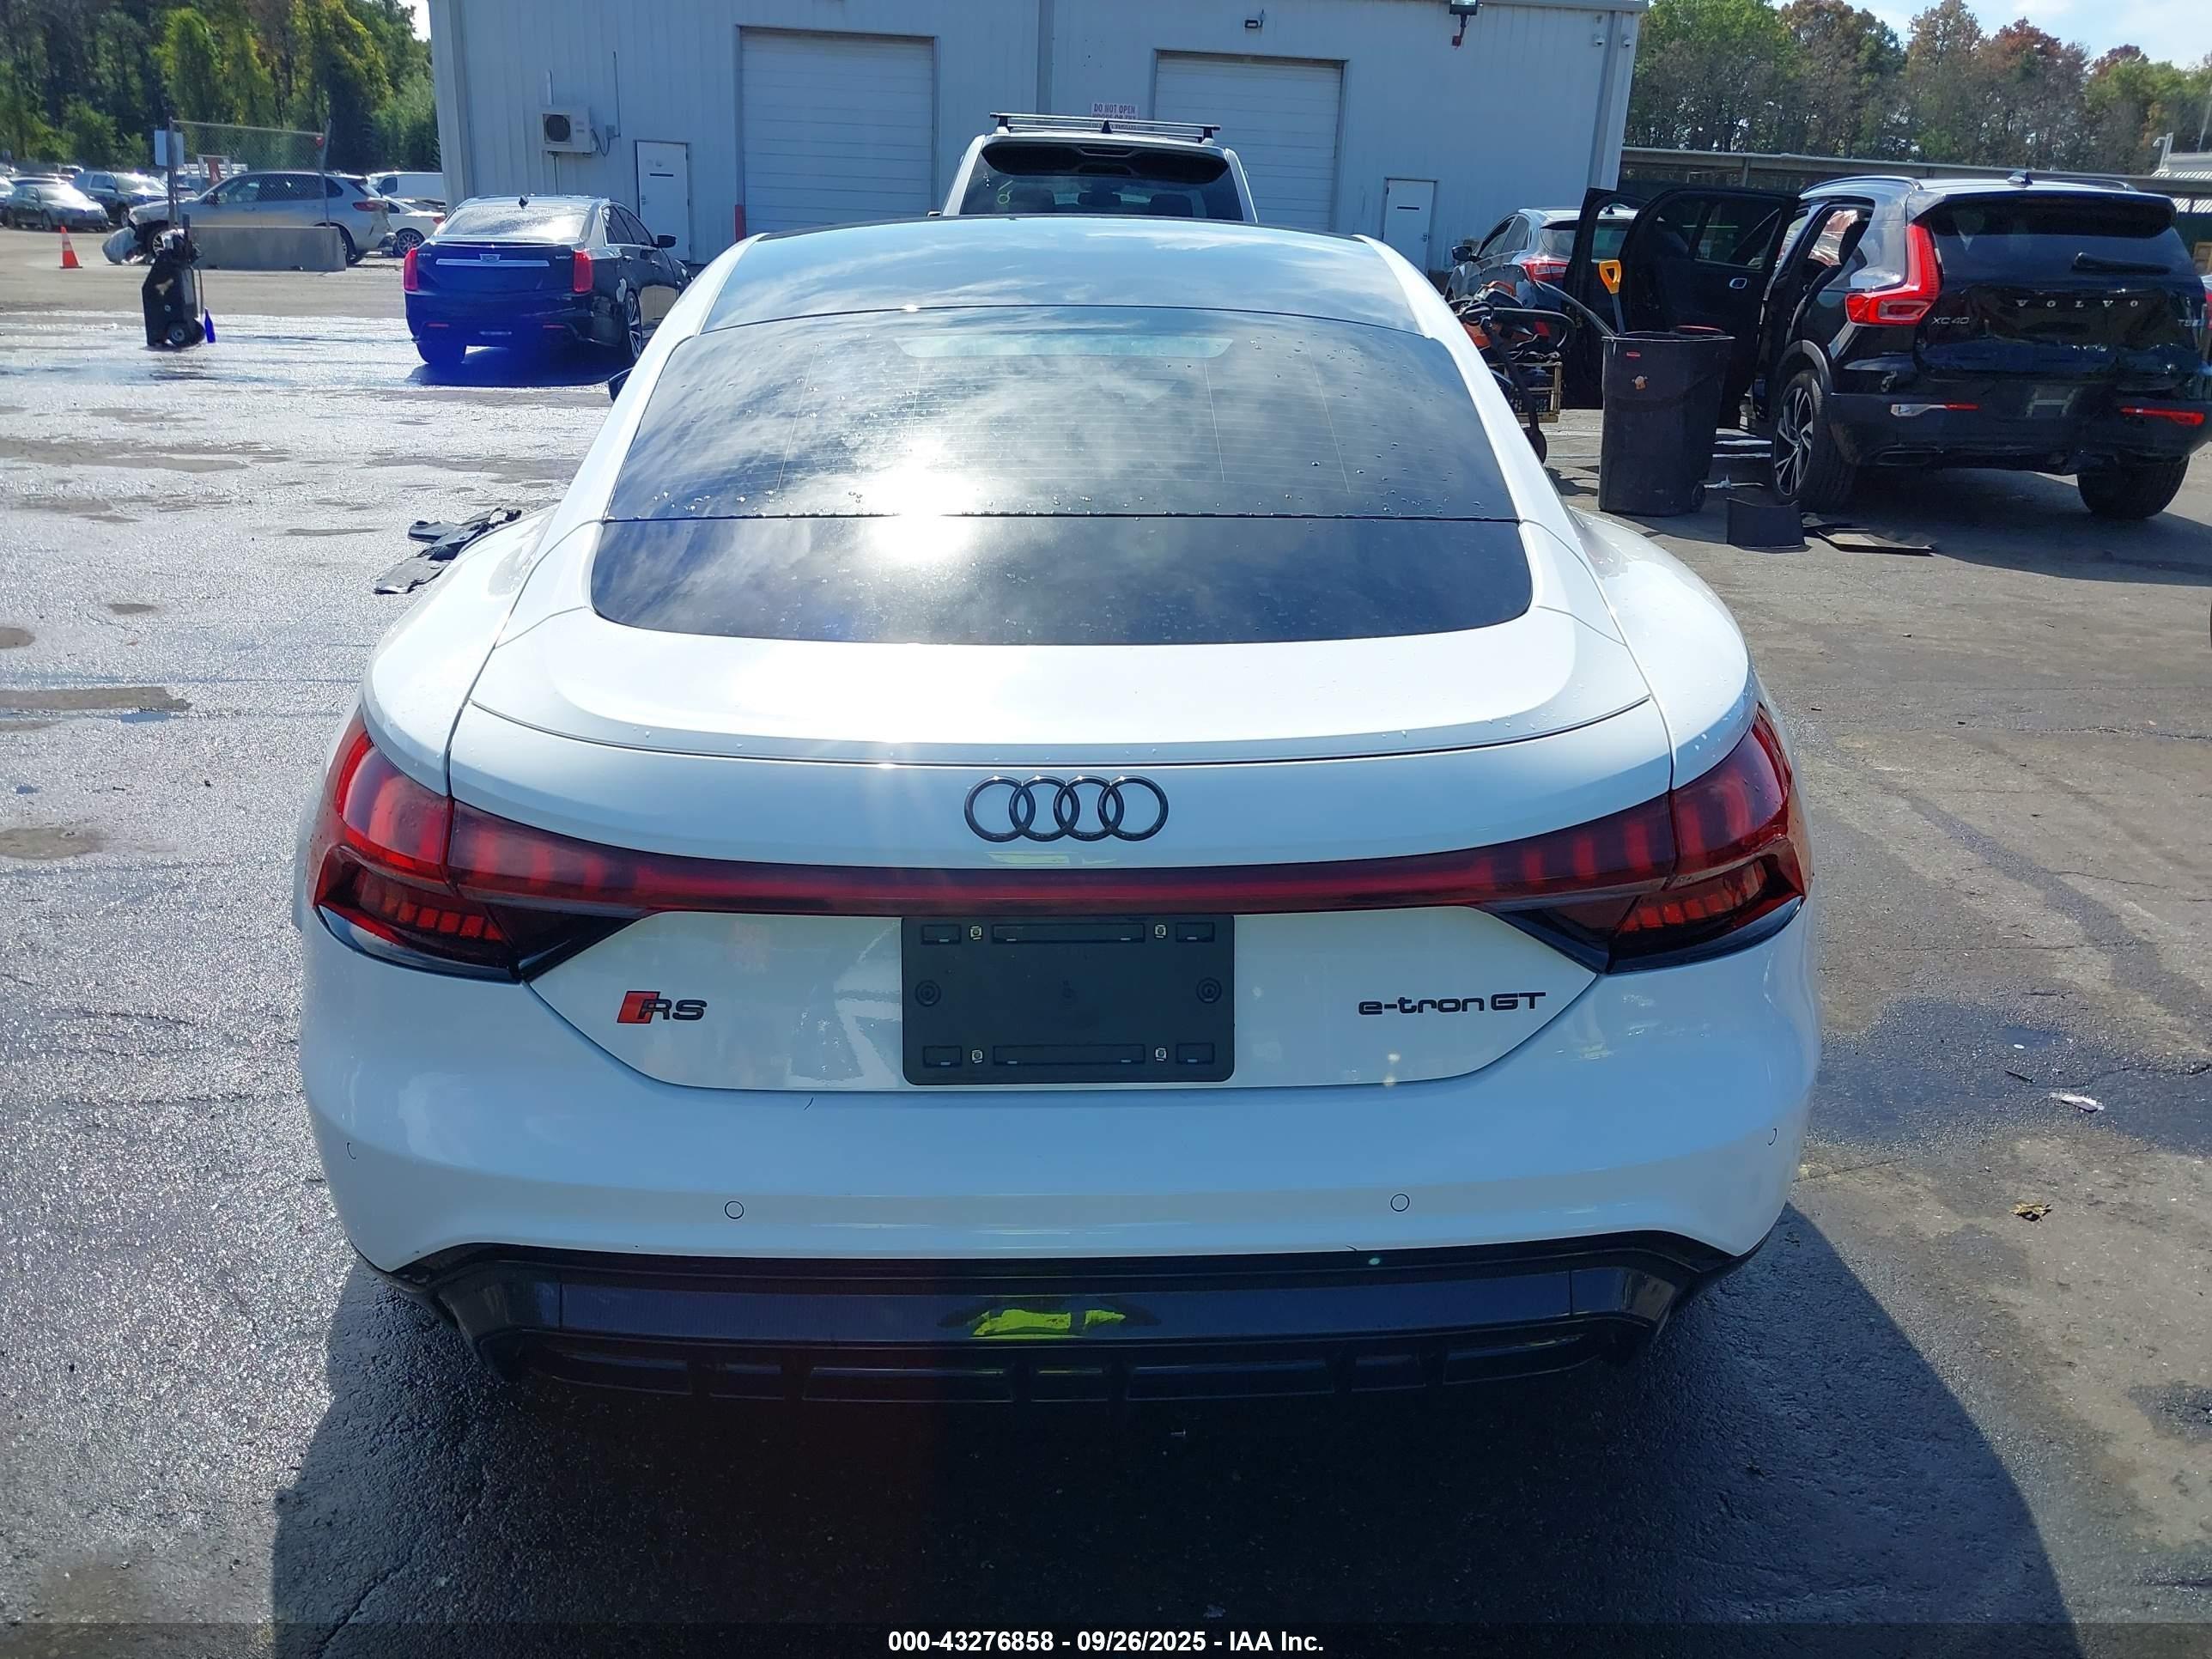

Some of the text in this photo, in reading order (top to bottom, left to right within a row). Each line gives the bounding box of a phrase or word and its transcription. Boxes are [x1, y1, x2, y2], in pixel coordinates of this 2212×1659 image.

[1094, 103, 1136, 114] DO NOT OPEN
[635, 998, 708, 1021] RS
[1358, 992, 1547, 1015] e-tron GT
